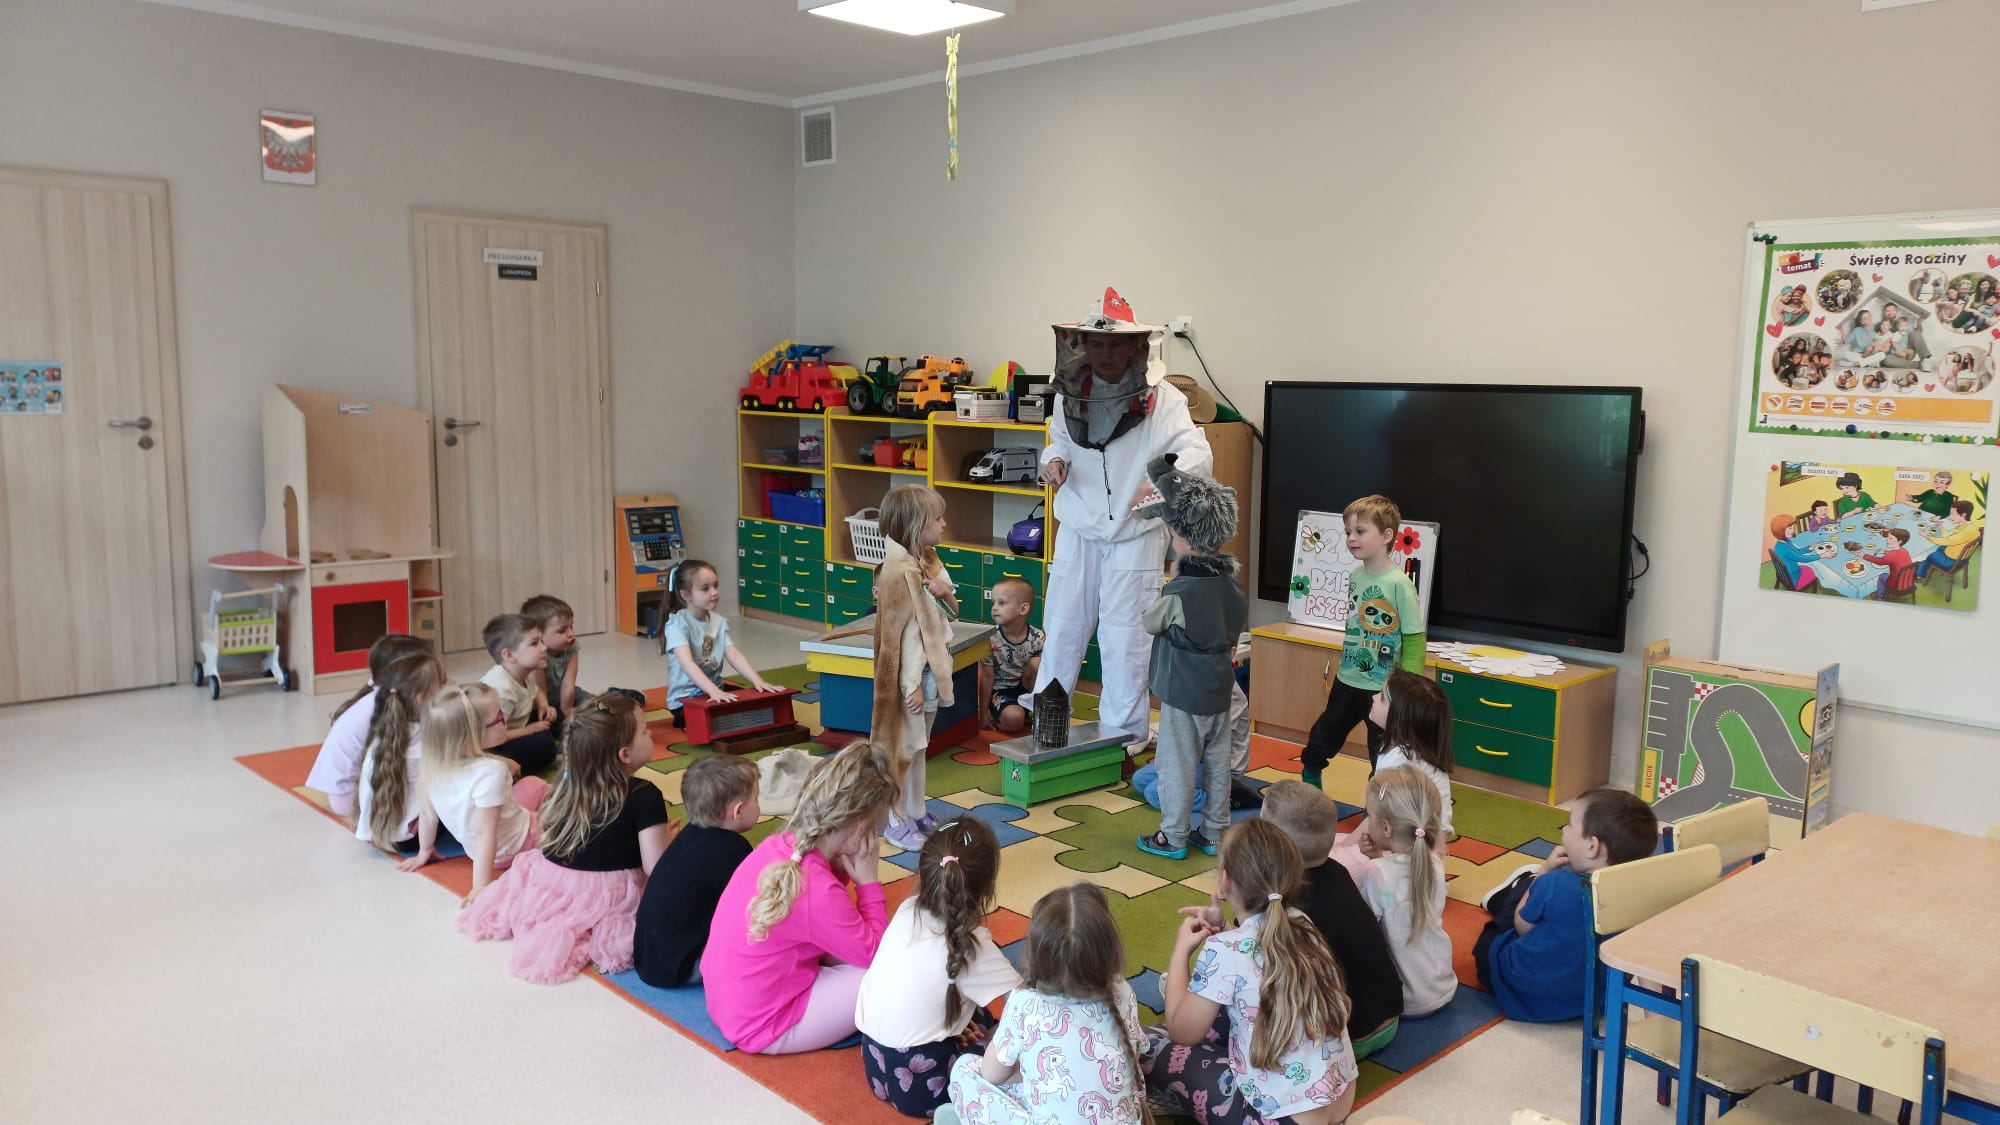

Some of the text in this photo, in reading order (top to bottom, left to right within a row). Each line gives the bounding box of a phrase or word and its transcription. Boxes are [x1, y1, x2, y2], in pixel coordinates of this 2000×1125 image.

[1787, 262, 1811, 272] temat
[1849, 251, 1967, 268] Święto Rodziny
[1310, 567, 1350, 594] DZIE
[1305, 595, 1350, 621] PSZC
